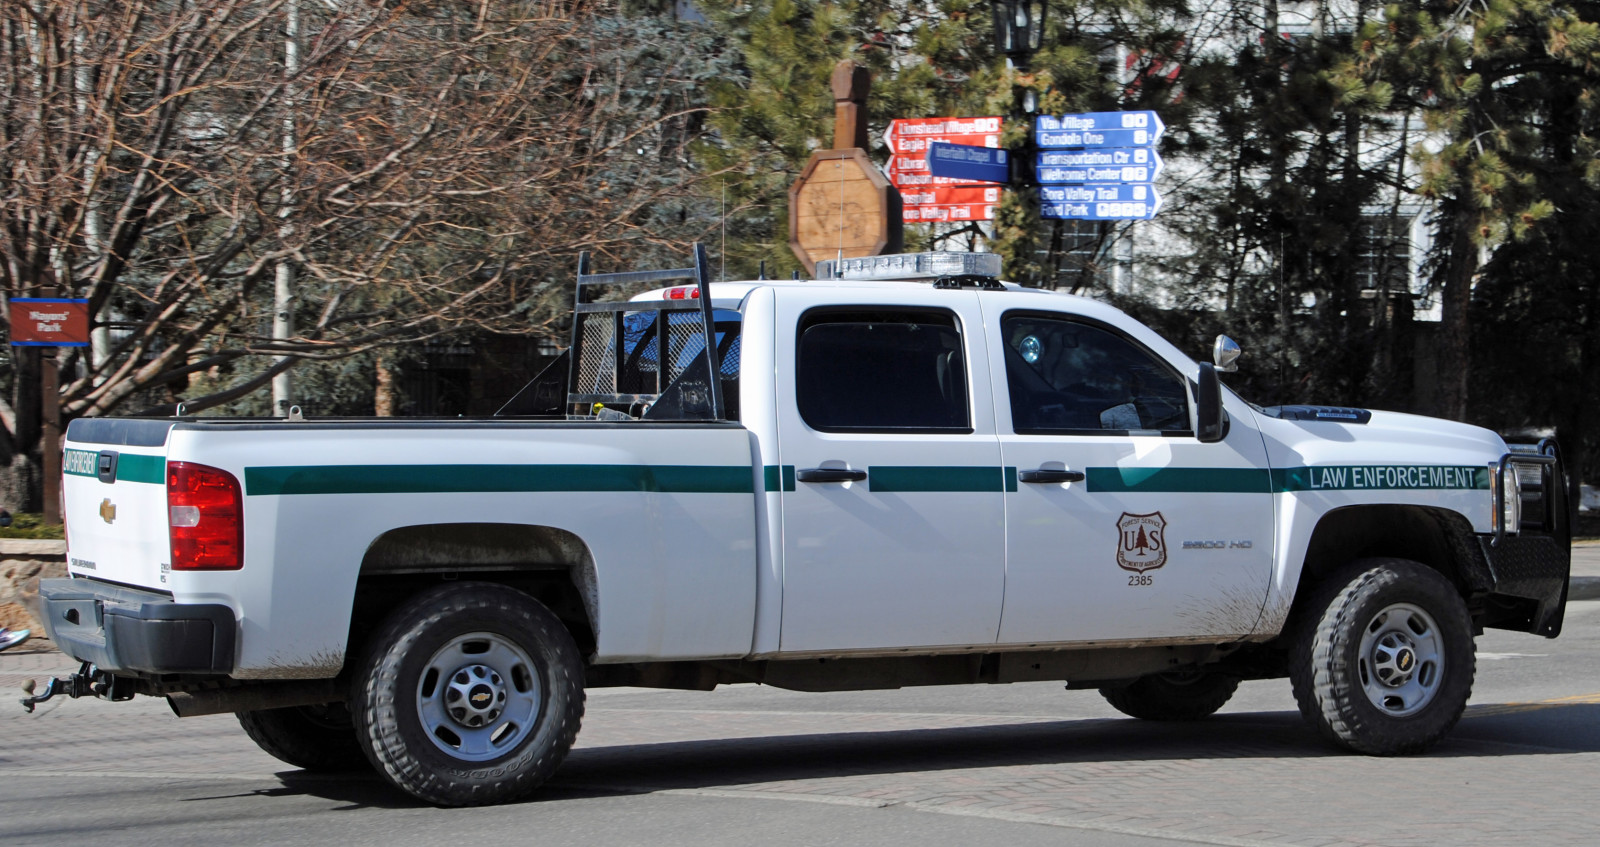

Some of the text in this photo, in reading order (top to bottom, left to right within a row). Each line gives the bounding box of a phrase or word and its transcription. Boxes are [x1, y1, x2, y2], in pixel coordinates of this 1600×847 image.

[898, 120, 975, 135] Lionshead Village
[1041, 116, 1095, 131] Vail Village
[898, 138, 925, 152] Eagle
[1041, 132, 1104, 145] Gondola One
[967, 148, 990, 164] Chapel
[1041, 151, 1130, 166] Transportation Ctr
[897, 173, 932, 185] Dobson
[1040, 167, 1121, 180] Welcome Center
[1041, 187, 1118, 202] Gore Valley Trail
[902, 206, 971, 221] ore Valley Trail
[1041, 204, 1089, 216] Ford Park
[37, 322, 62, 332] Park
[1310, 467, 1475, 489] LAW ENFORCEMENT
[1122, 518, 1160, 529] FOREST SERVICE
[1128, 575, 1153, 586] 2385
